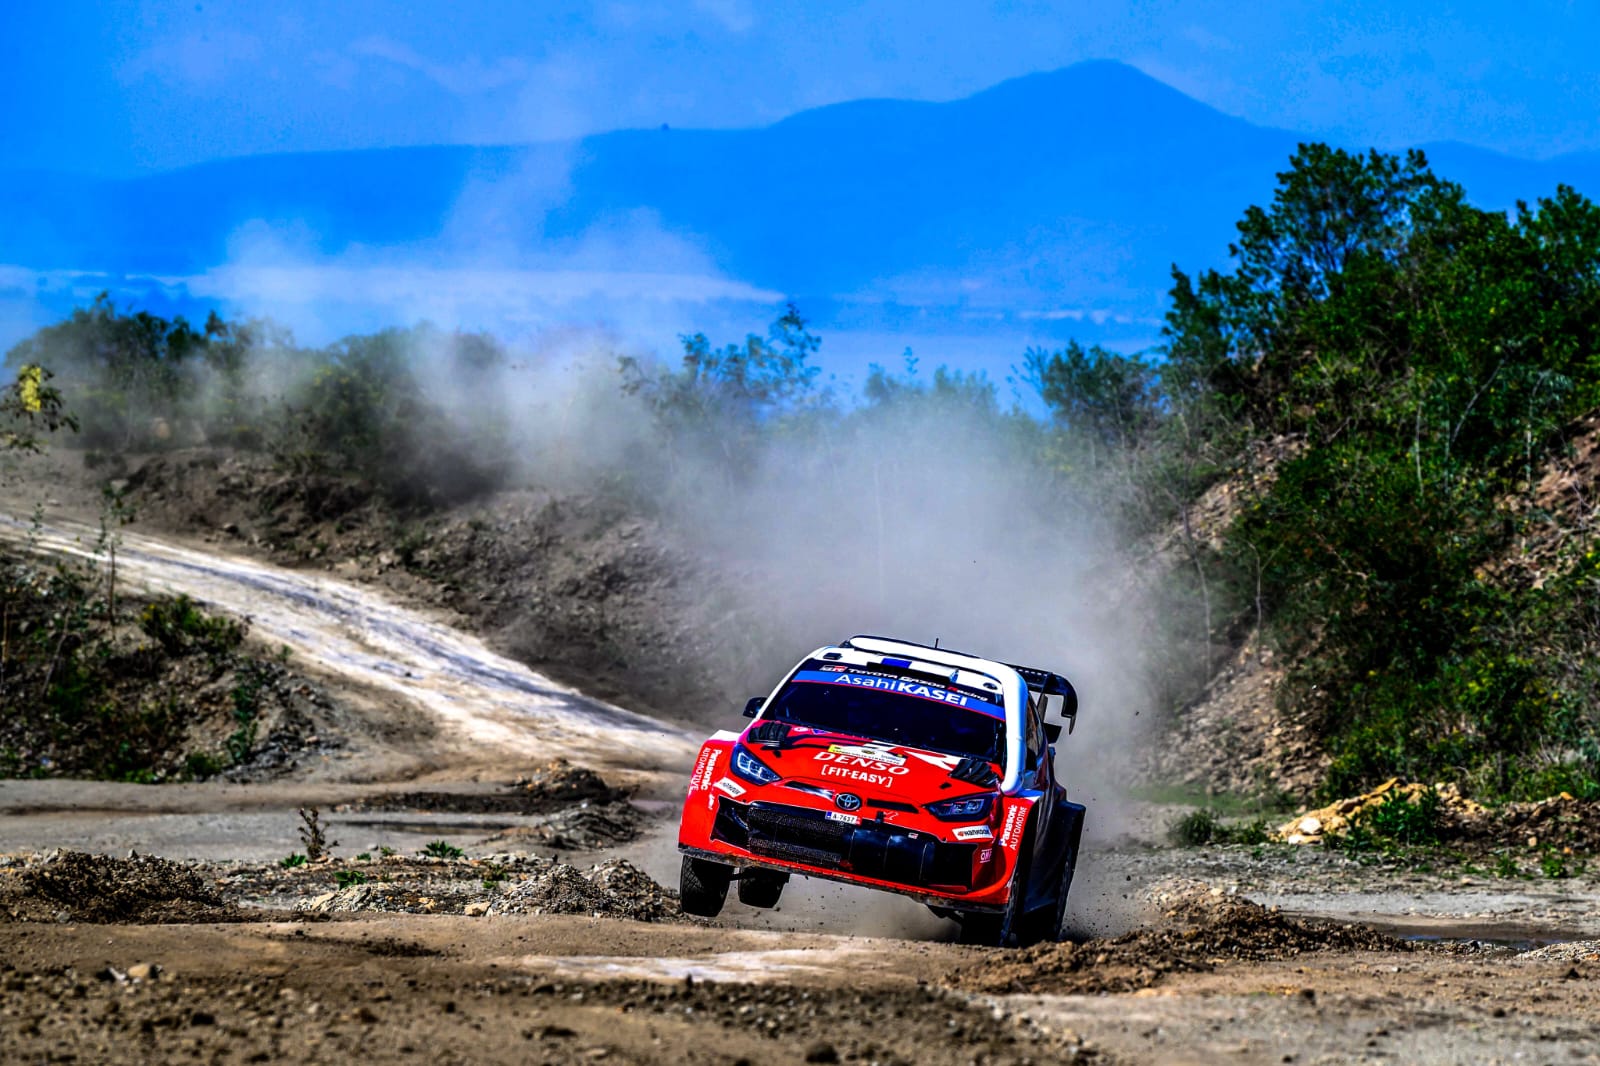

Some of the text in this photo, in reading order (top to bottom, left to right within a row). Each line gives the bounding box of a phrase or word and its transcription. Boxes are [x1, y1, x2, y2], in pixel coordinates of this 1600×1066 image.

[700, 749, 723, 791] Panasonic
[813, 751, 910, 776] DENSO
[1001, 804, 1018, 847] Panasonic
[1009, 806, 1028, 851] AUTOMOTIVE
